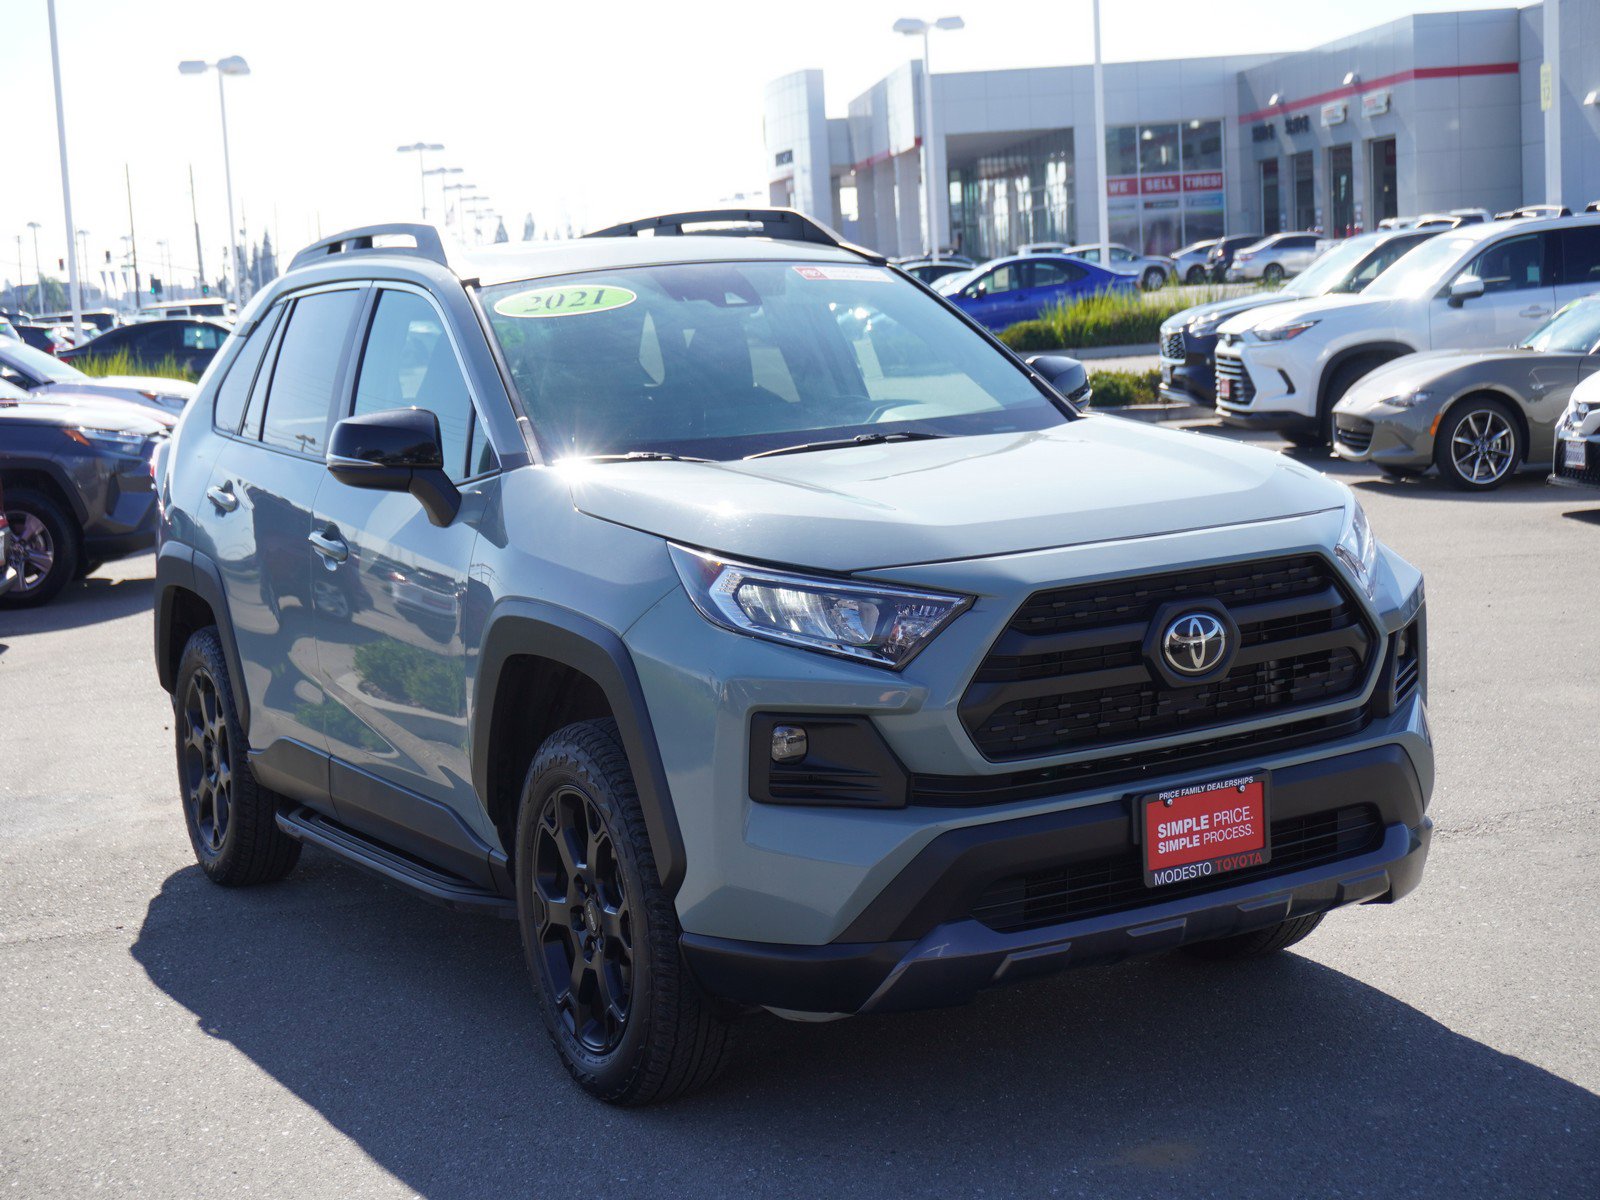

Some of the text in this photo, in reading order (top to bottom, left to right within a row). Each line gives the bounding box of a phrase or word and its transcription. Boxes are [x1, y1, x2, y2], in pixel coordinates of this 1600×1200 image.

[1108, 174, 1222, 193] WE SELL TIRES!
[523, 289, 606, 313] 2021
[1159, 776, 1253, 800] PRICE FAMILY DEALERSHIPS
[1158, 806, 1254, 838] SIMPLE PRICE.
[1158, 823, 1255, 854] SIMPLE PROCESS.
[1154, 853, 1262, 886] MODESTO TOYOTA
